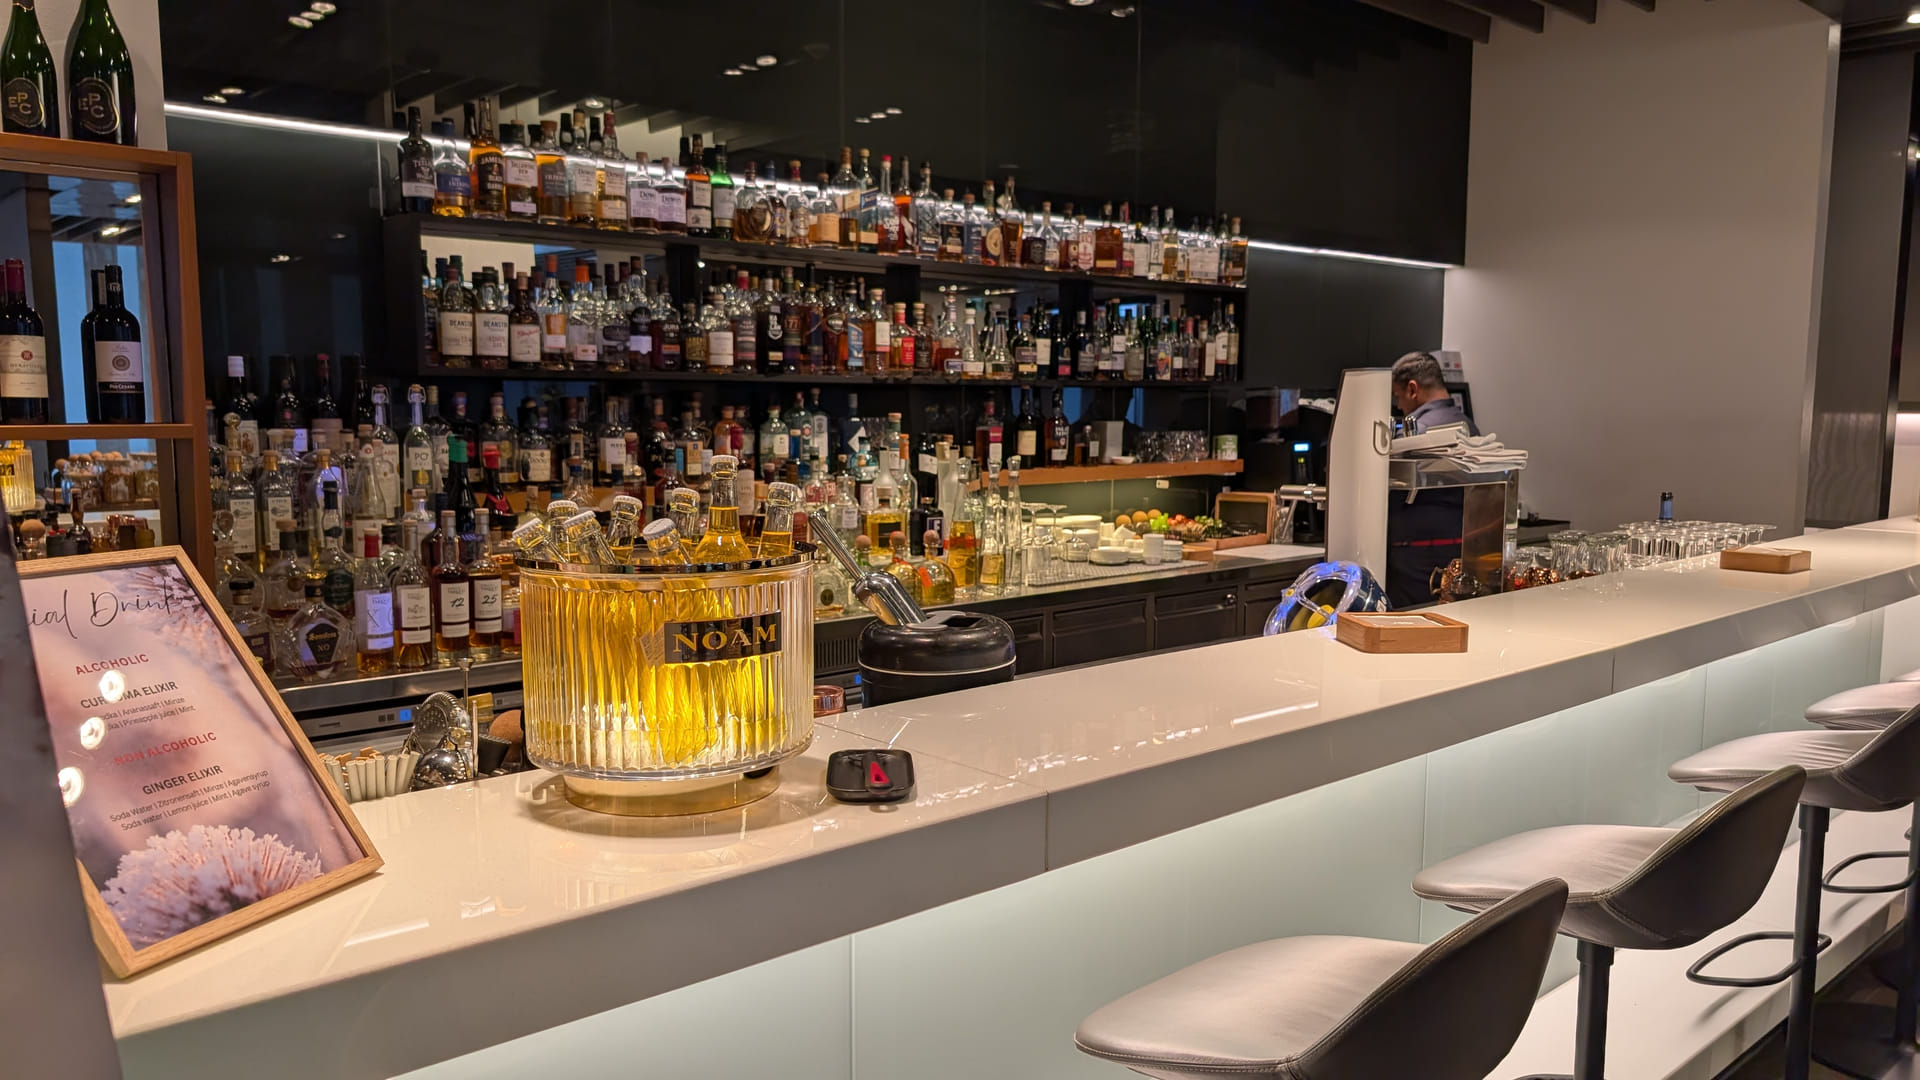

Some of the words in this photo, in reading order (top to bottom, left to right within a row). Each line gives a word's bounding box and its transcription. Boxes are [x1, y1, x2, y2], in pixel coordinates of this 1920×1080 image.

[28, 589, 77, 639] ial
[481, 594, 498, 605] 25
[672, 623, 777, 653] NOAM
[76, 653, 150, 676] ALCOHOLIC
[80, 689, 142, 709] CURMA
[142, 681, 179, 697] ELIXIR
[122, 702, 162, 716] Ananassaft
[163, 697, 186, 707] Minze
[123, 714, 159, 727] Pineapple
[114, 750, 146, 766] NON
[147, 732, 217, 762] ALCOHOLIC
[142, 774, 188, 796] GINGER
[187, 765, 224, 782] ELIXIR
[110, 810, 131, 823] Soda
[130, 804, 153, 817] Water
[204, 783, 226, 795] Minze
[121, 820, 142, 831] Soda
[142, 814, 163, 825] water
[167, 805, 193, 818] Lemon
[192, 800, 210, 812] juice
[211, 793, 230, 803] Mint
[232, 786, 255, 799] Agave
[253, 780, 271, 792] syrup
